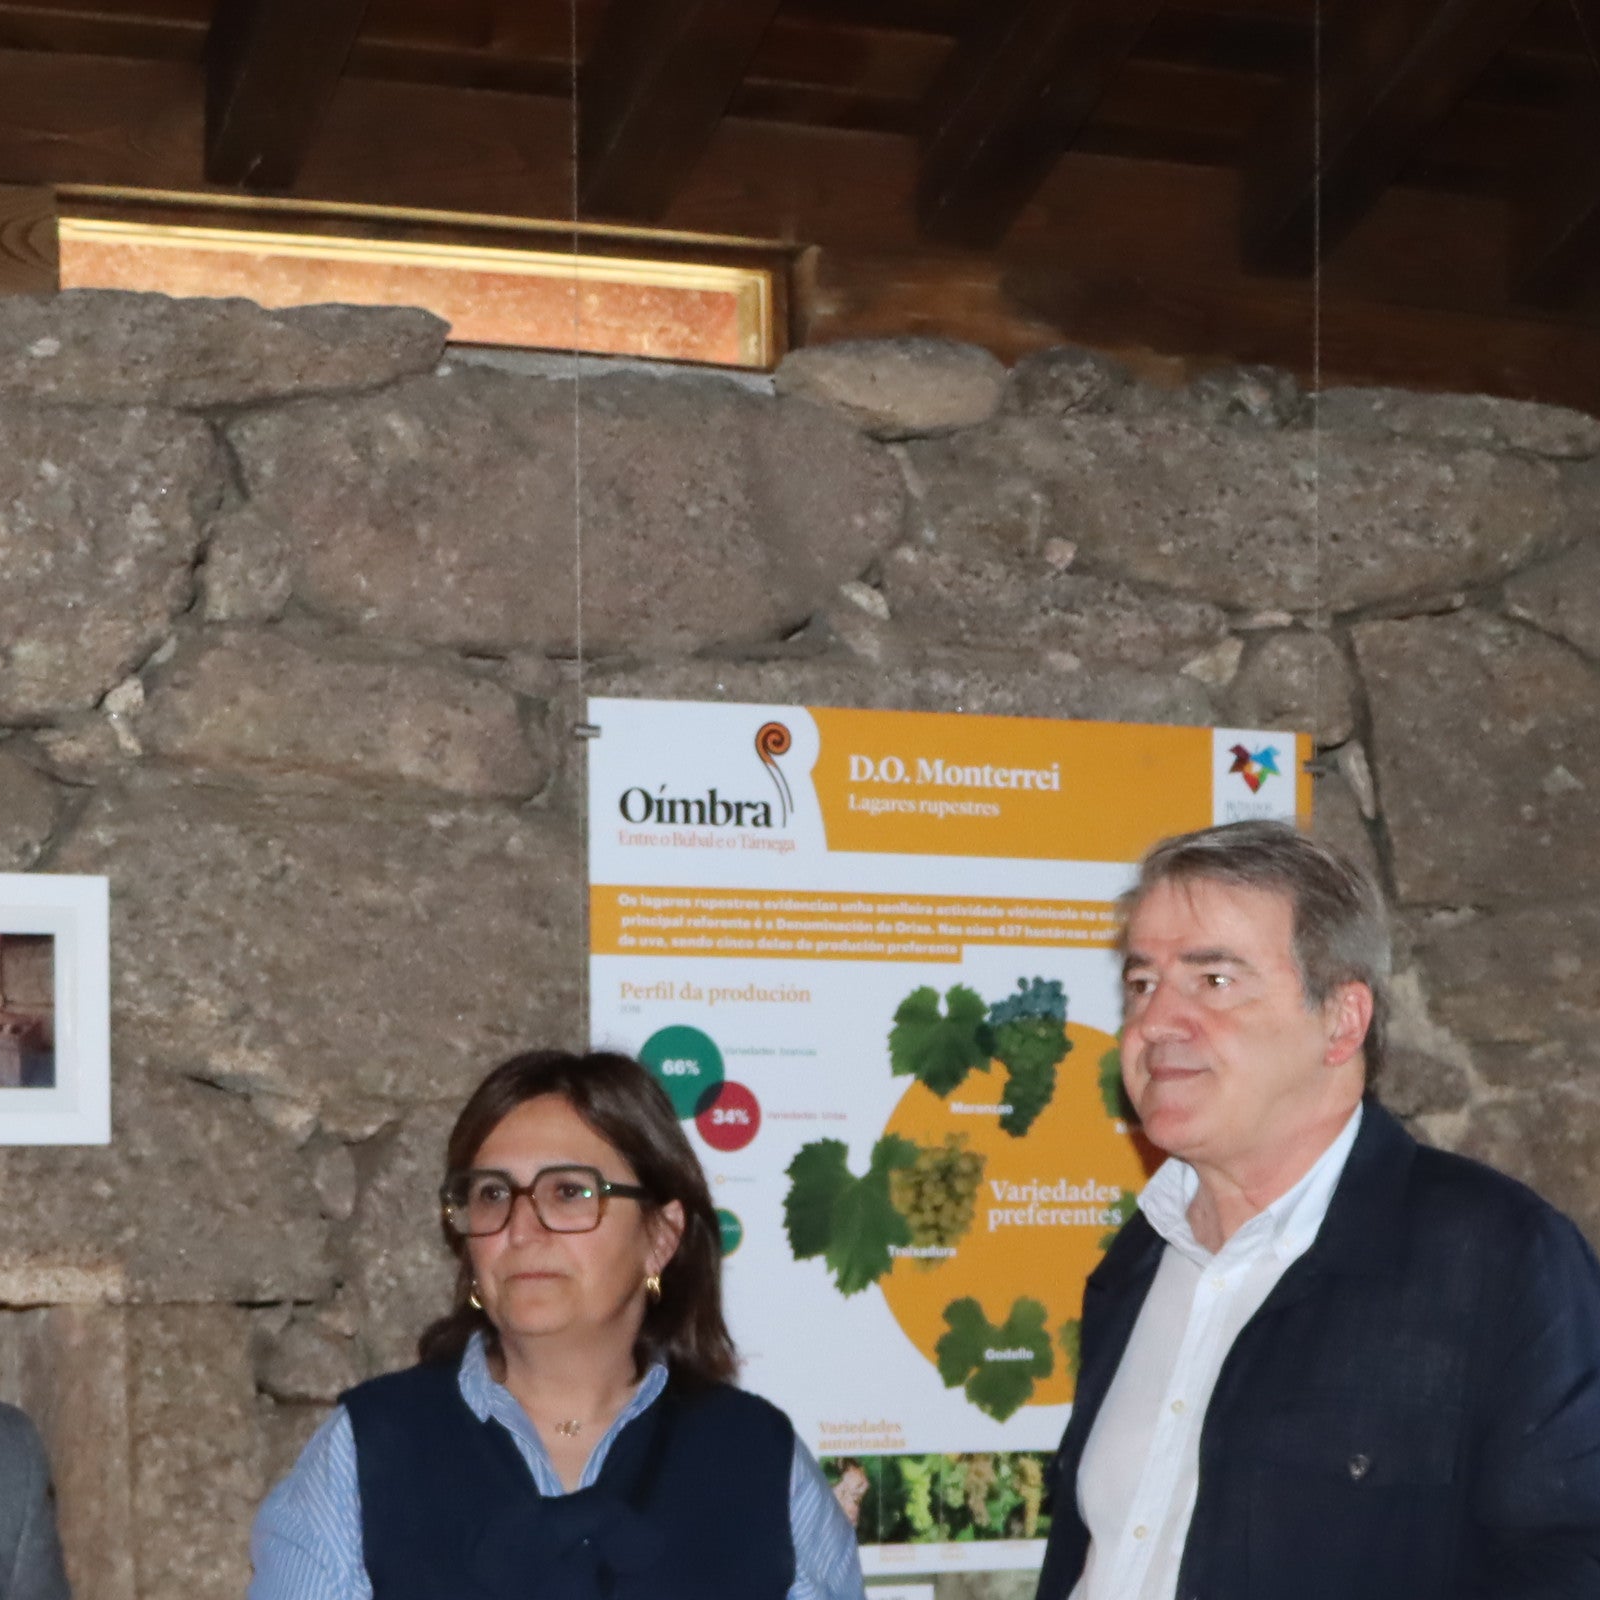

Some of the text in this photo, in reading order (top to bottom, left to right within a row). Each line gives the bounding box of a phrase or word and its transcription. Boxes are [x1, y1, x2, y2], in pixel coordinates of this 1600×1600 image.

[850, 754, 1061, 790] D.O. Monterrei
[618, 783, 773, 829] Oímbra
[849, 793, 1001, 818] Lagares rupestres
[620, 981, 812, 1006] Perfil da produción
[661, 1058, 700, 1077] 66%
[712, 1107, 750, 1126] 34%
[988, 1178, 1121, 1202] Variedades
[988, 1202, 1122, 1231] preferentes
[984, 1348, 1035, 1362] Godello
